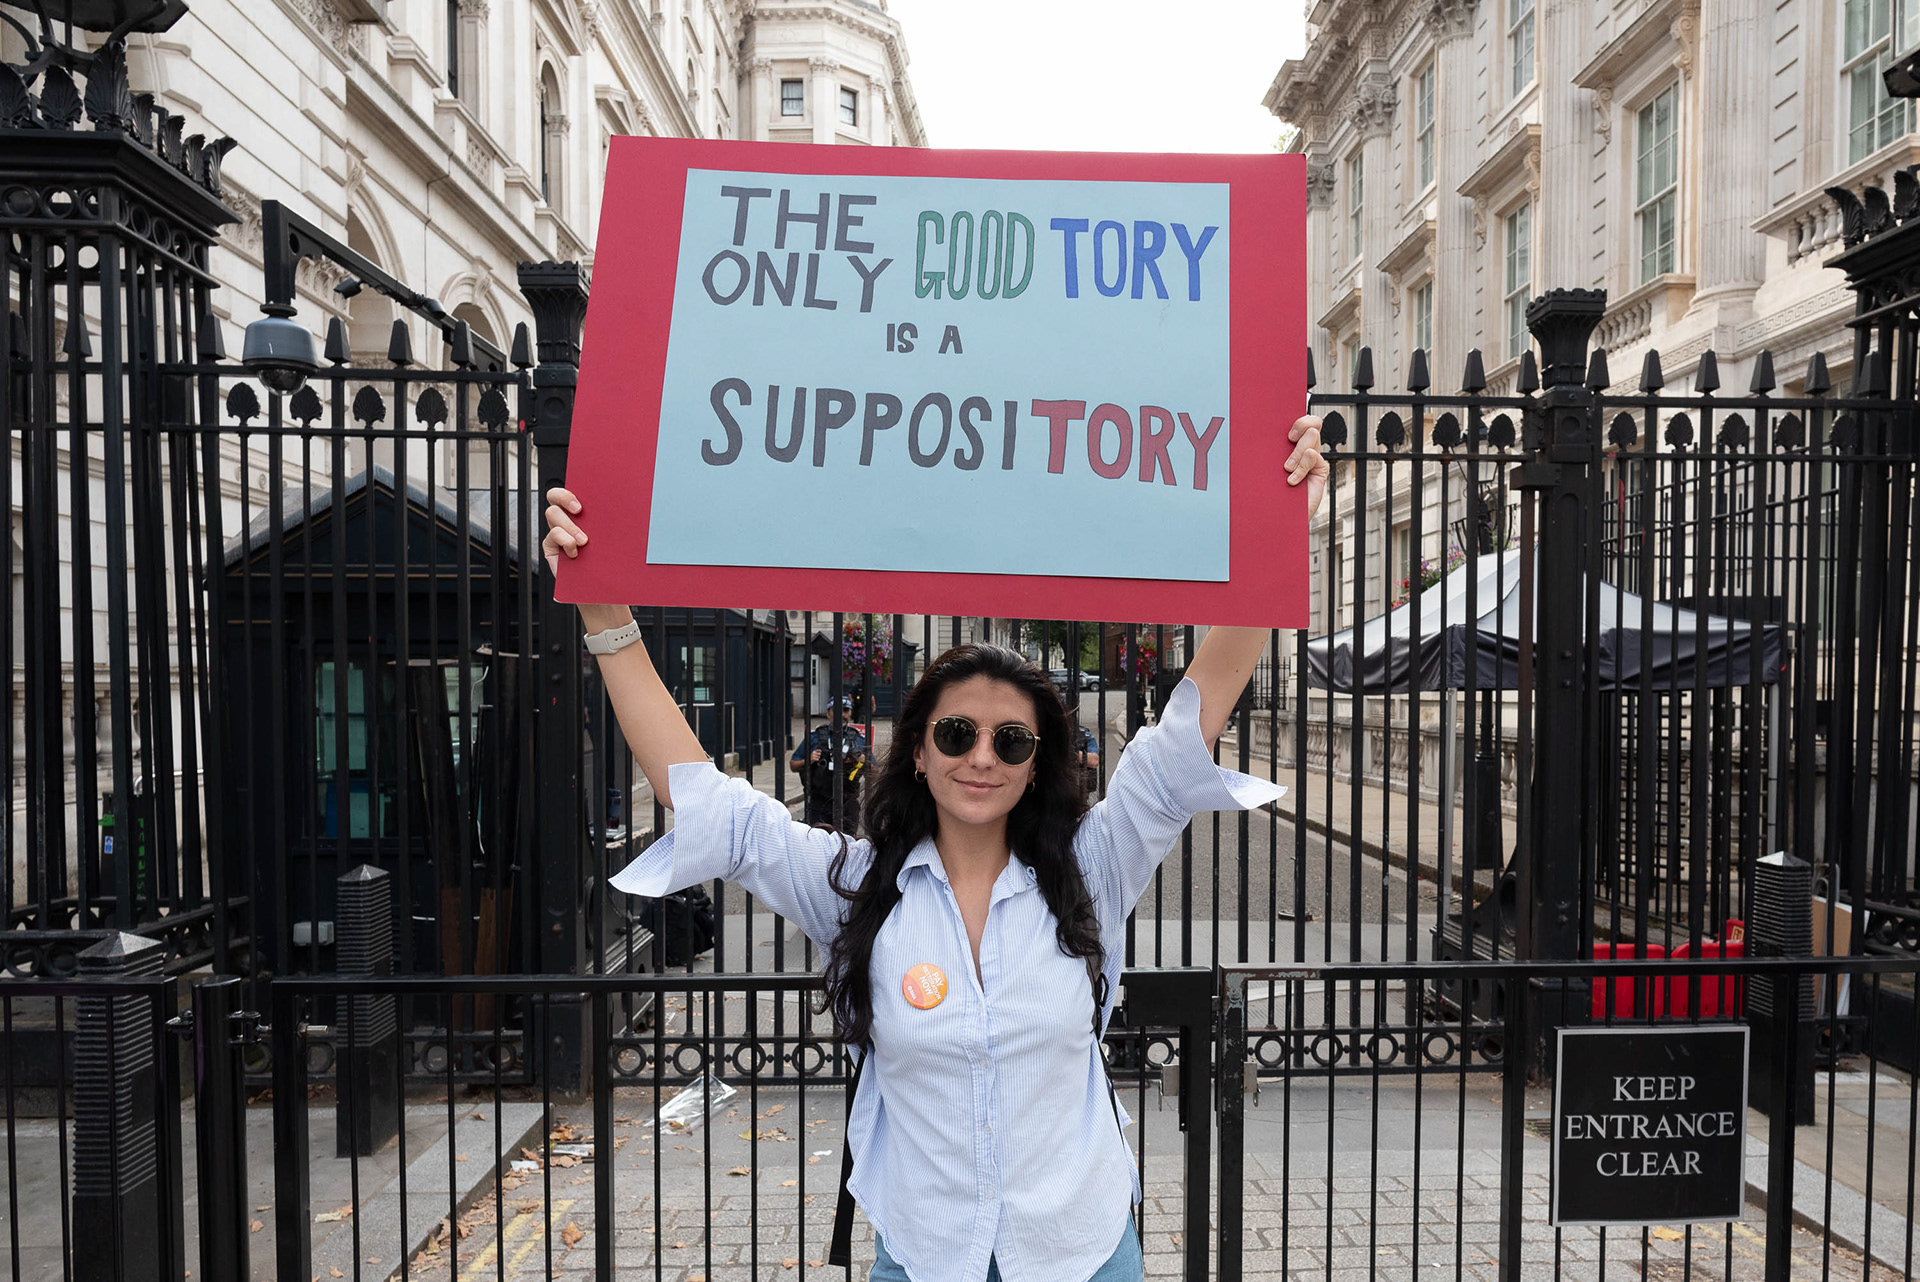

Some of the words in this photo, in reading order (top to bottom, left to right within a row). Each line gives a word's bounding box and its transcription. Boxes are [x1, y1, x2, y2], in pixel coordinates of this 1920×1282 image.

[721, 185, 877, 254] THE
[915, 210, 1035, 300] GOOD
[1050, 218, 1219, 301] TORY
[702, 250, 894, 313] ONLY
[887, 323, 918, 353] IS
[938, 325, 963, 354] A
[701, 378, 1225, 491] SUPPOSITORY
[920, 976, 933, 995] NOW
[932, 972, 944, 986] PAY
[1613, 1076, 1696, 1101] KEEP
[1565, 1111, 1736, 1139] ENTRANCE
[1597, 1151, 1702, 1176] CLEAR
